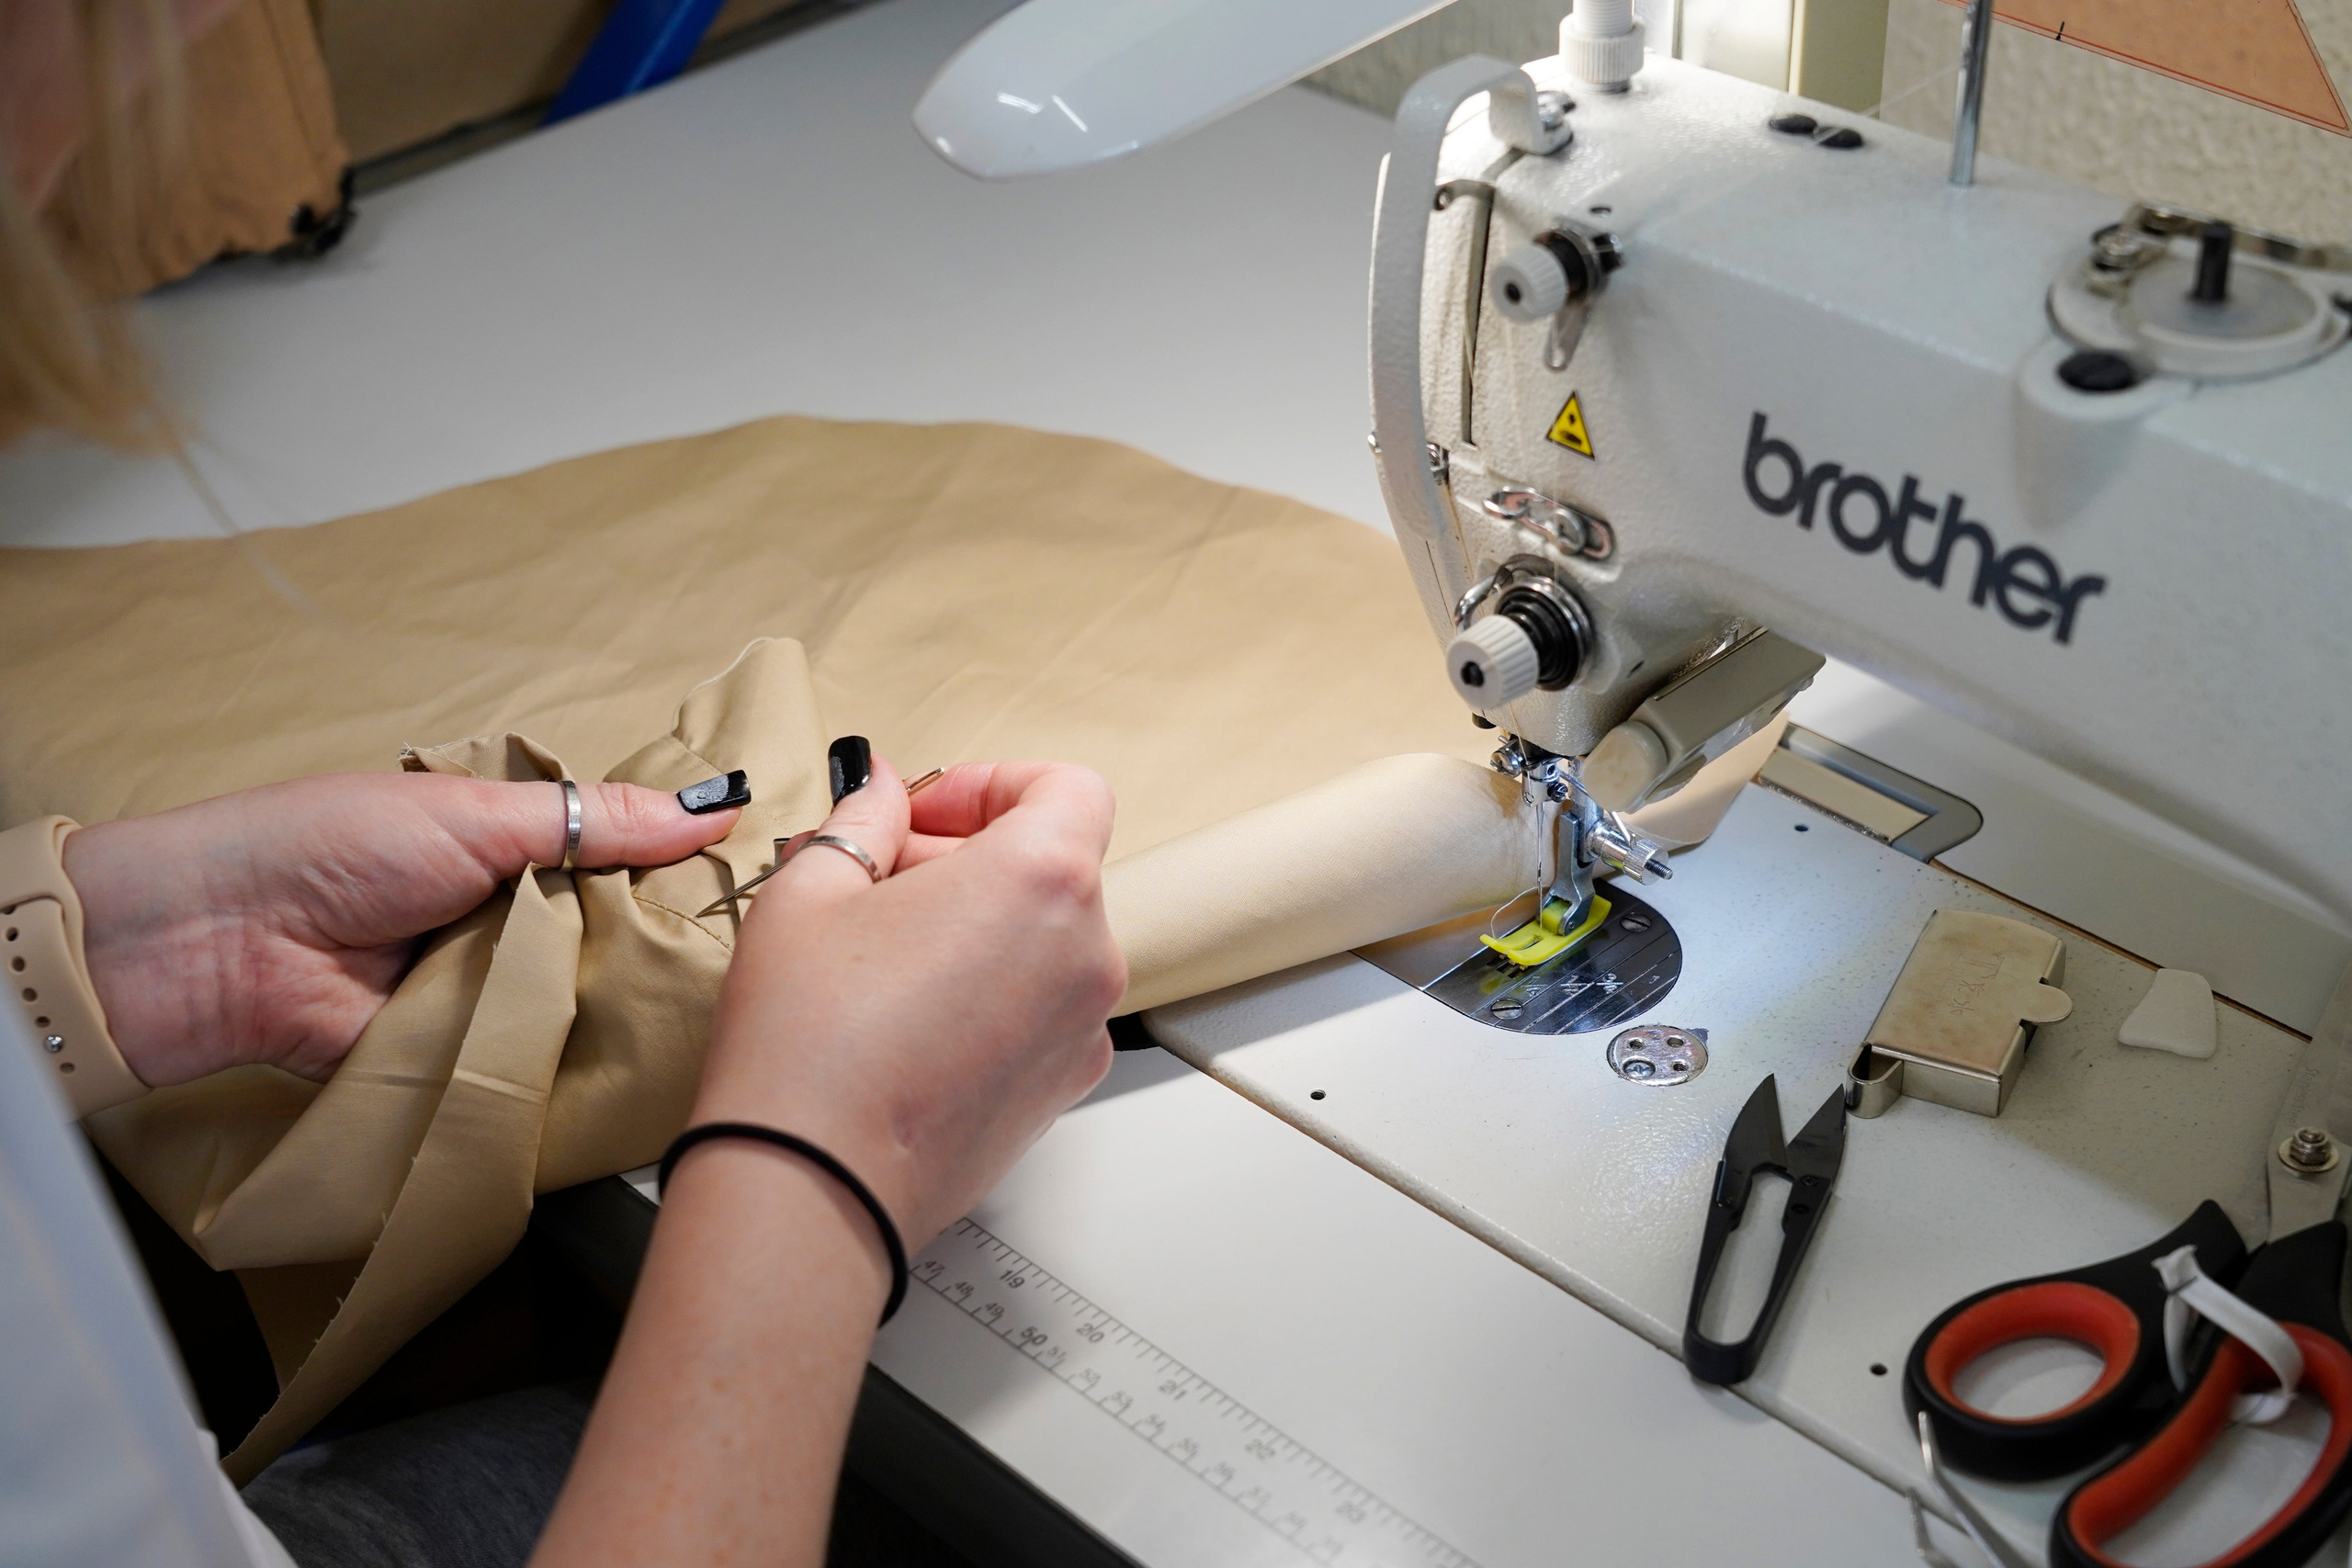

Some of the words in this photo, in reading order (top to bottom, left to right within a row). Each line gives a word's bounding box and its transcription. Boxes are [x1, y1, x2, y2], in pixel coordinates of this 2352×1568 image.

[1742, 411, 2107, 646] brother
[922, 1259, 945, 1275] 47
[955, 1281, 974, 1297] 48
[984, 1302, 1005, 1317] 49
[1021, 1325, 1048, 1346] 50
[999, 1269, 1025, 1289] 19
[1076, 1323, 1105, 1344] 20
[1158, 1379, 1187, 1401] 21
[1244, 1438, 1276, 1462] 22
